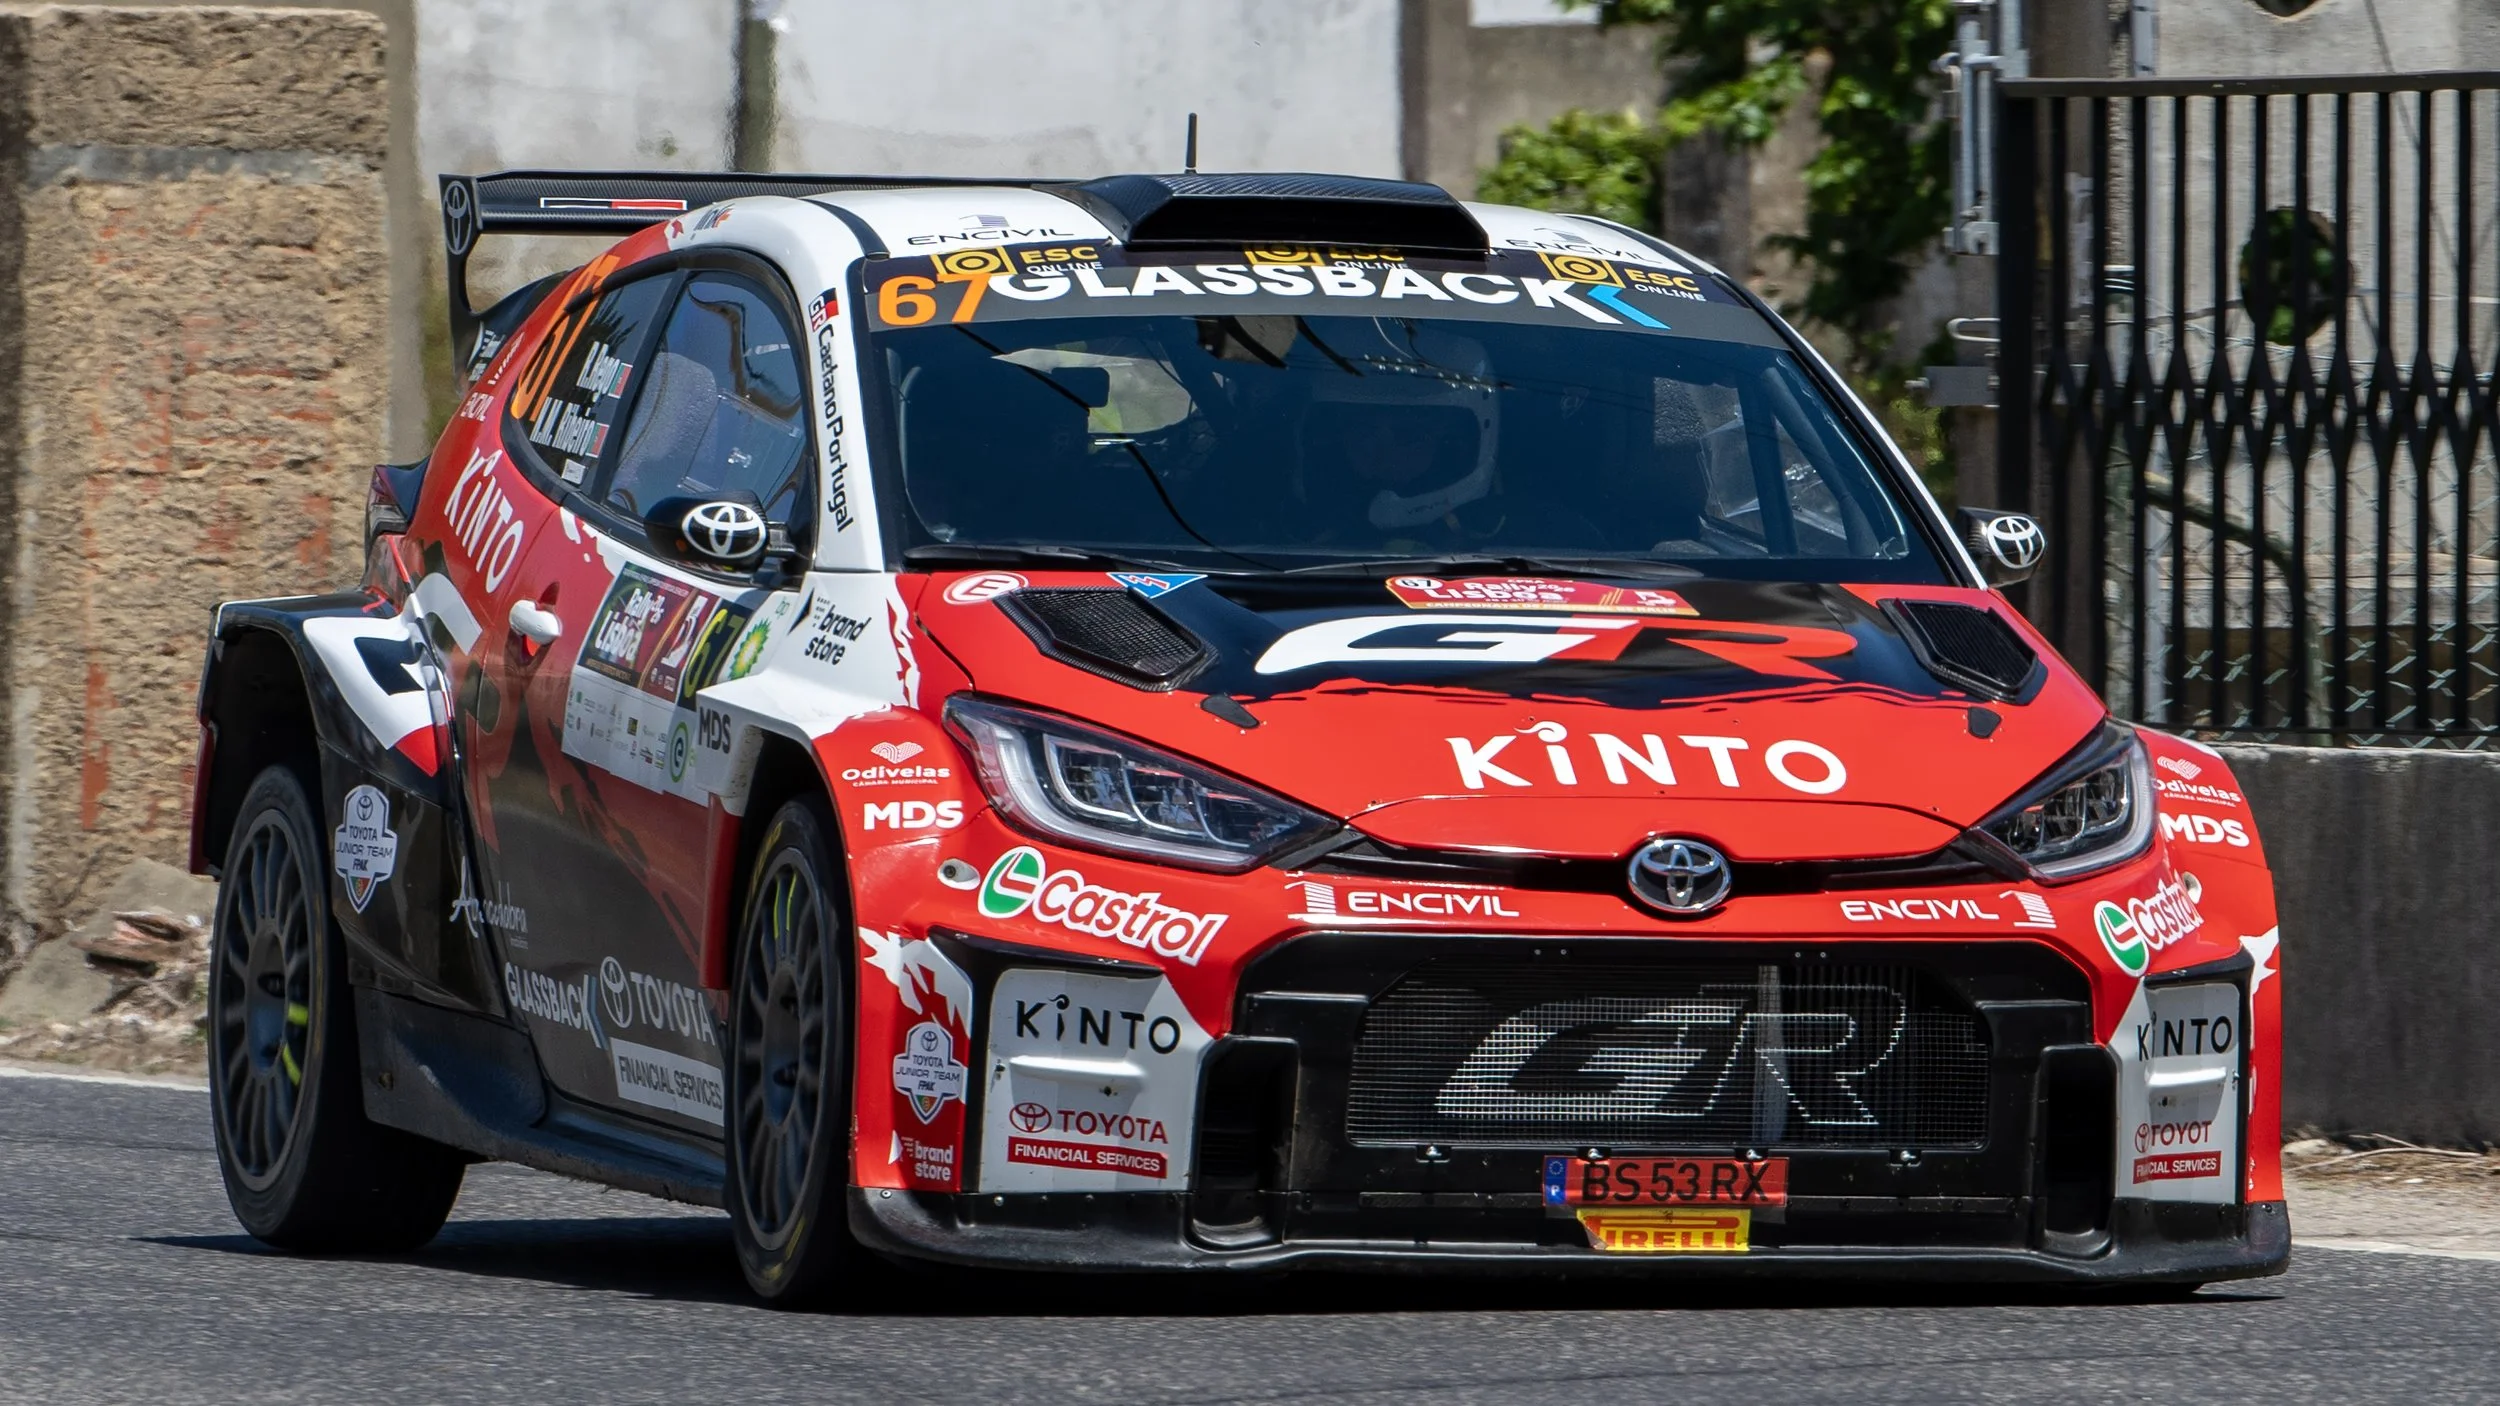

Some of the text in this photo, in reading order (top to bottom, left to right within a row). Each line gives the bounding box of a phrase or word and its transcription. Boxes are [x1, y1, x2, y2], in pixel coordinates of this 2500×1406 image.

[907, 227, 1075, 246] ENCIVIL
[1021, 246, 1100, 265] ESC
[1505, 238, 1662, 264] ENCIVIL
[1026, 261, 1104, 276] ONLINE
[1623, 267, 1701, 293] ESC
[877, 273, 992, 326] 67
[989, 264, 1624, 326] GLASSBACK
[1635, 283, 1707, 301] ONLINE
[1400, 578, 1433, 588] 67
[775, 597, 791, 620] bp
[818, 604, 872, 642] brand
[804, 635, 846, 666] store
[1254, 613, 1858, 681] GR
[699, 706, 732, 755] MDS
[841, 765, 951, 781] Odivelas
[863, 799, 964, 830] MDS
[348, 825, 378, 842] TOYOTA
[2159, 812, 2250, 848] MDS
[335, 842, 393, 859] JUNIOR TEAM
[1347, 891, 1520, 917] ENCIVIL
[1839, 899, 2000, 921] ENCIVIL
[1036, 870, 1228, 967] Castrol
[504, 961, 600, 1049] GLASSBACK
[630, 970, 716, 1047] TOYOTA
[911, 1053, 944, 1069] TOYOTA
[618, 1055, 723, 1111] FINANCIAL SERVICES
[895, 1067, 961, 1082] JUNIOR TEAM
[1058, 1108, 1169, 1144] TOYOTA
[914, 1139, 954, 1164] brand
[1013, 1143, 1161, 1173] FINANCIAL SERVICES
[914, 1163, 951, 1182] store
[2172, 1157, 2217, 1174] SERVICES
[1551, 1184, 1560, 1196] P
[1582, 1161, 1771, 1202] BS 53 RX
